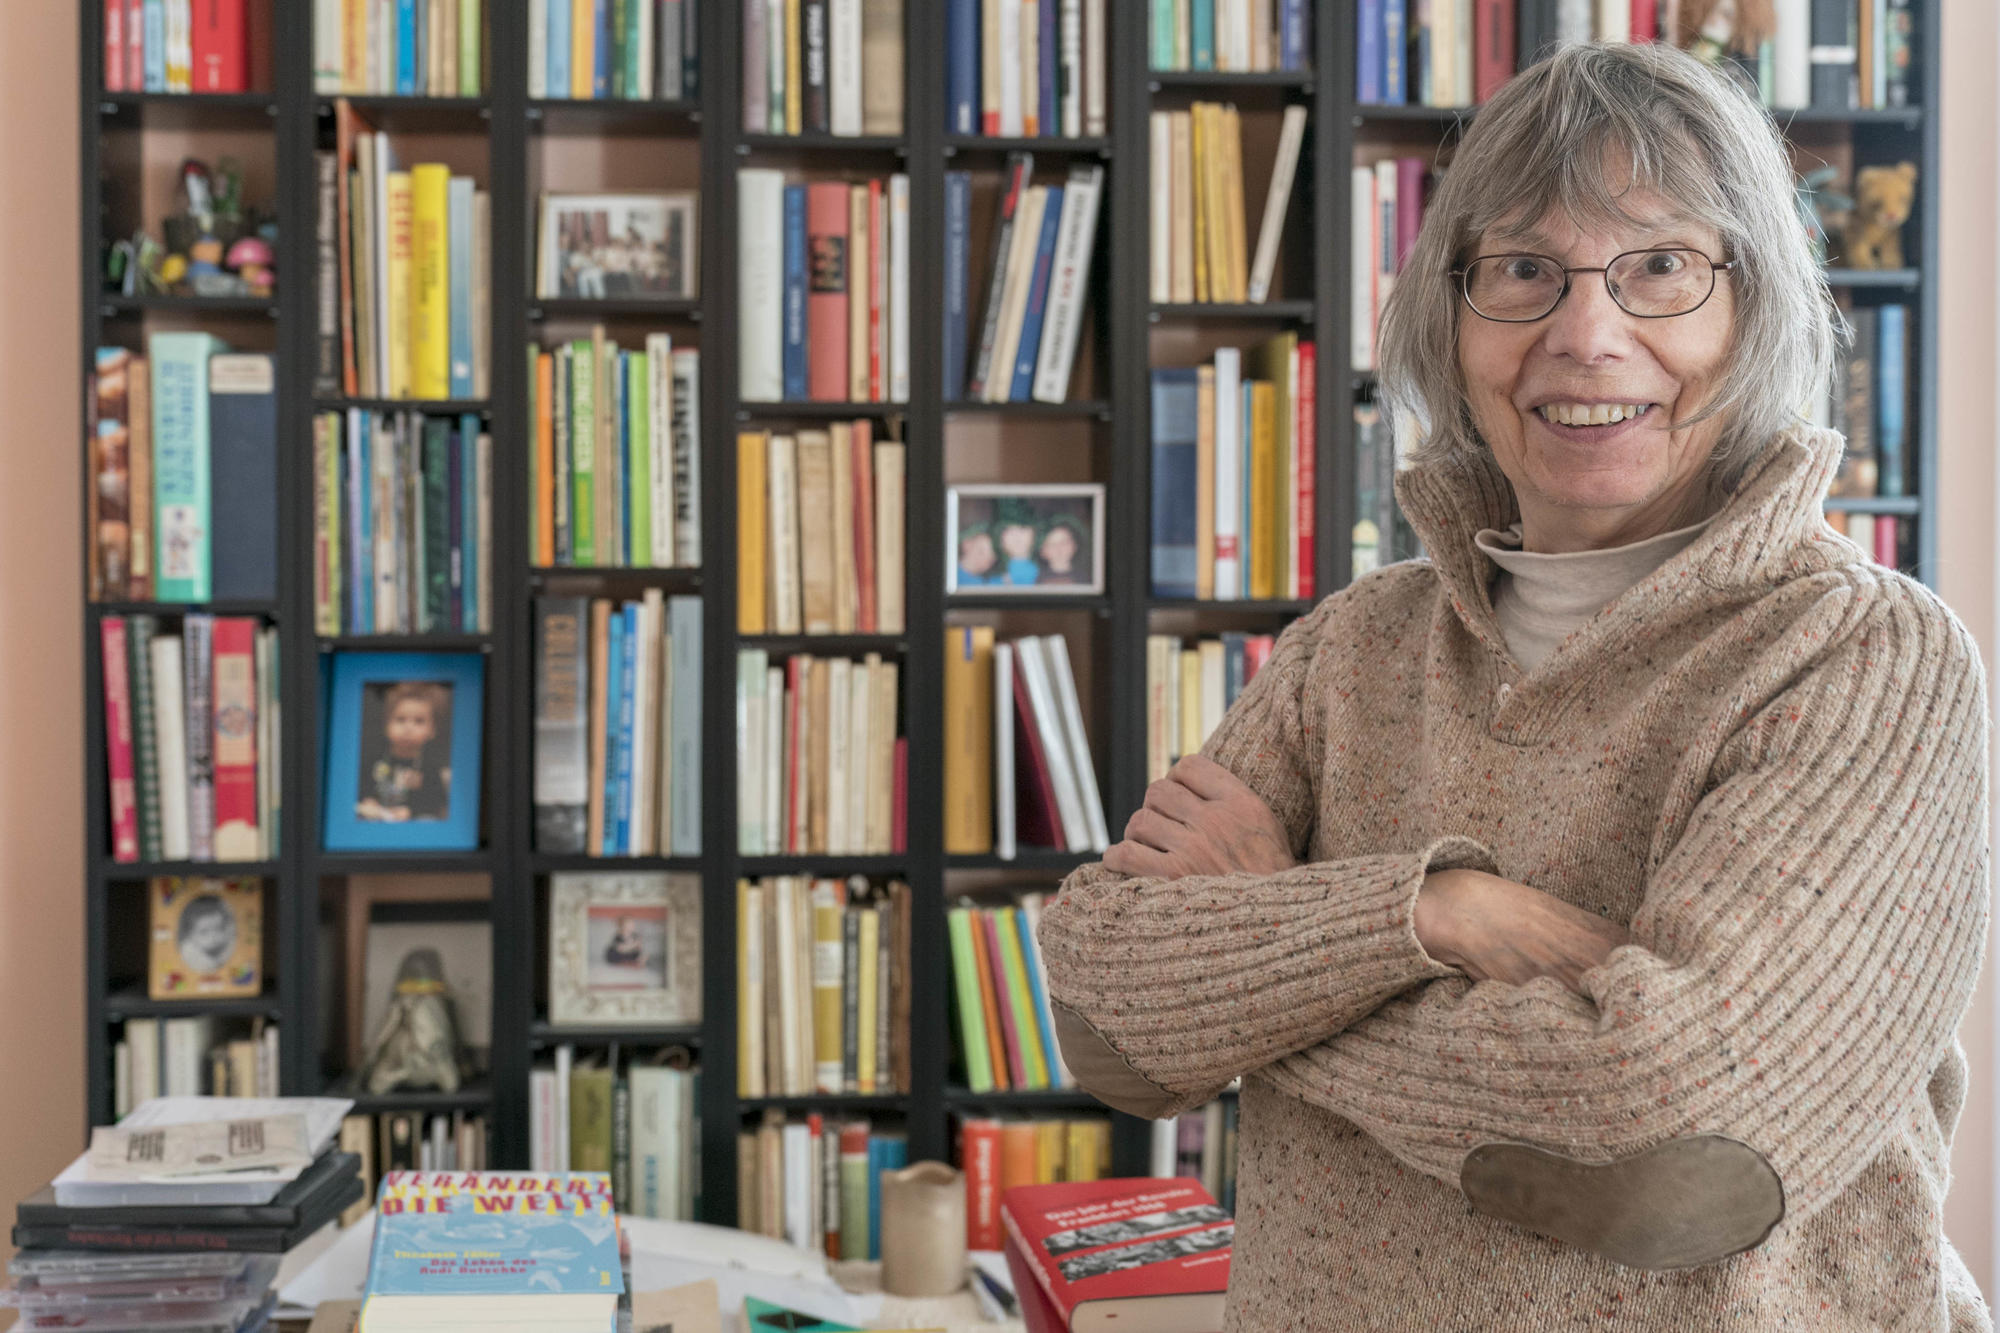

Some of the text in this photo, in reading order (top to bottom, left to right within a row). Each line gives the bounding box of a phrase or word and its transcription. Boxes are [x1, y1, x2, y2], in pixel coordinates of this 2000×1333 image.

[672, 376, 691, 522] EINSTEIN
[381, 1195, 453, 1216] DIE
[1111, 1198, 1136, 1208] der
[431, 1259, 457, 1267] Das
[464, 1259, 505, 1267] Leben
